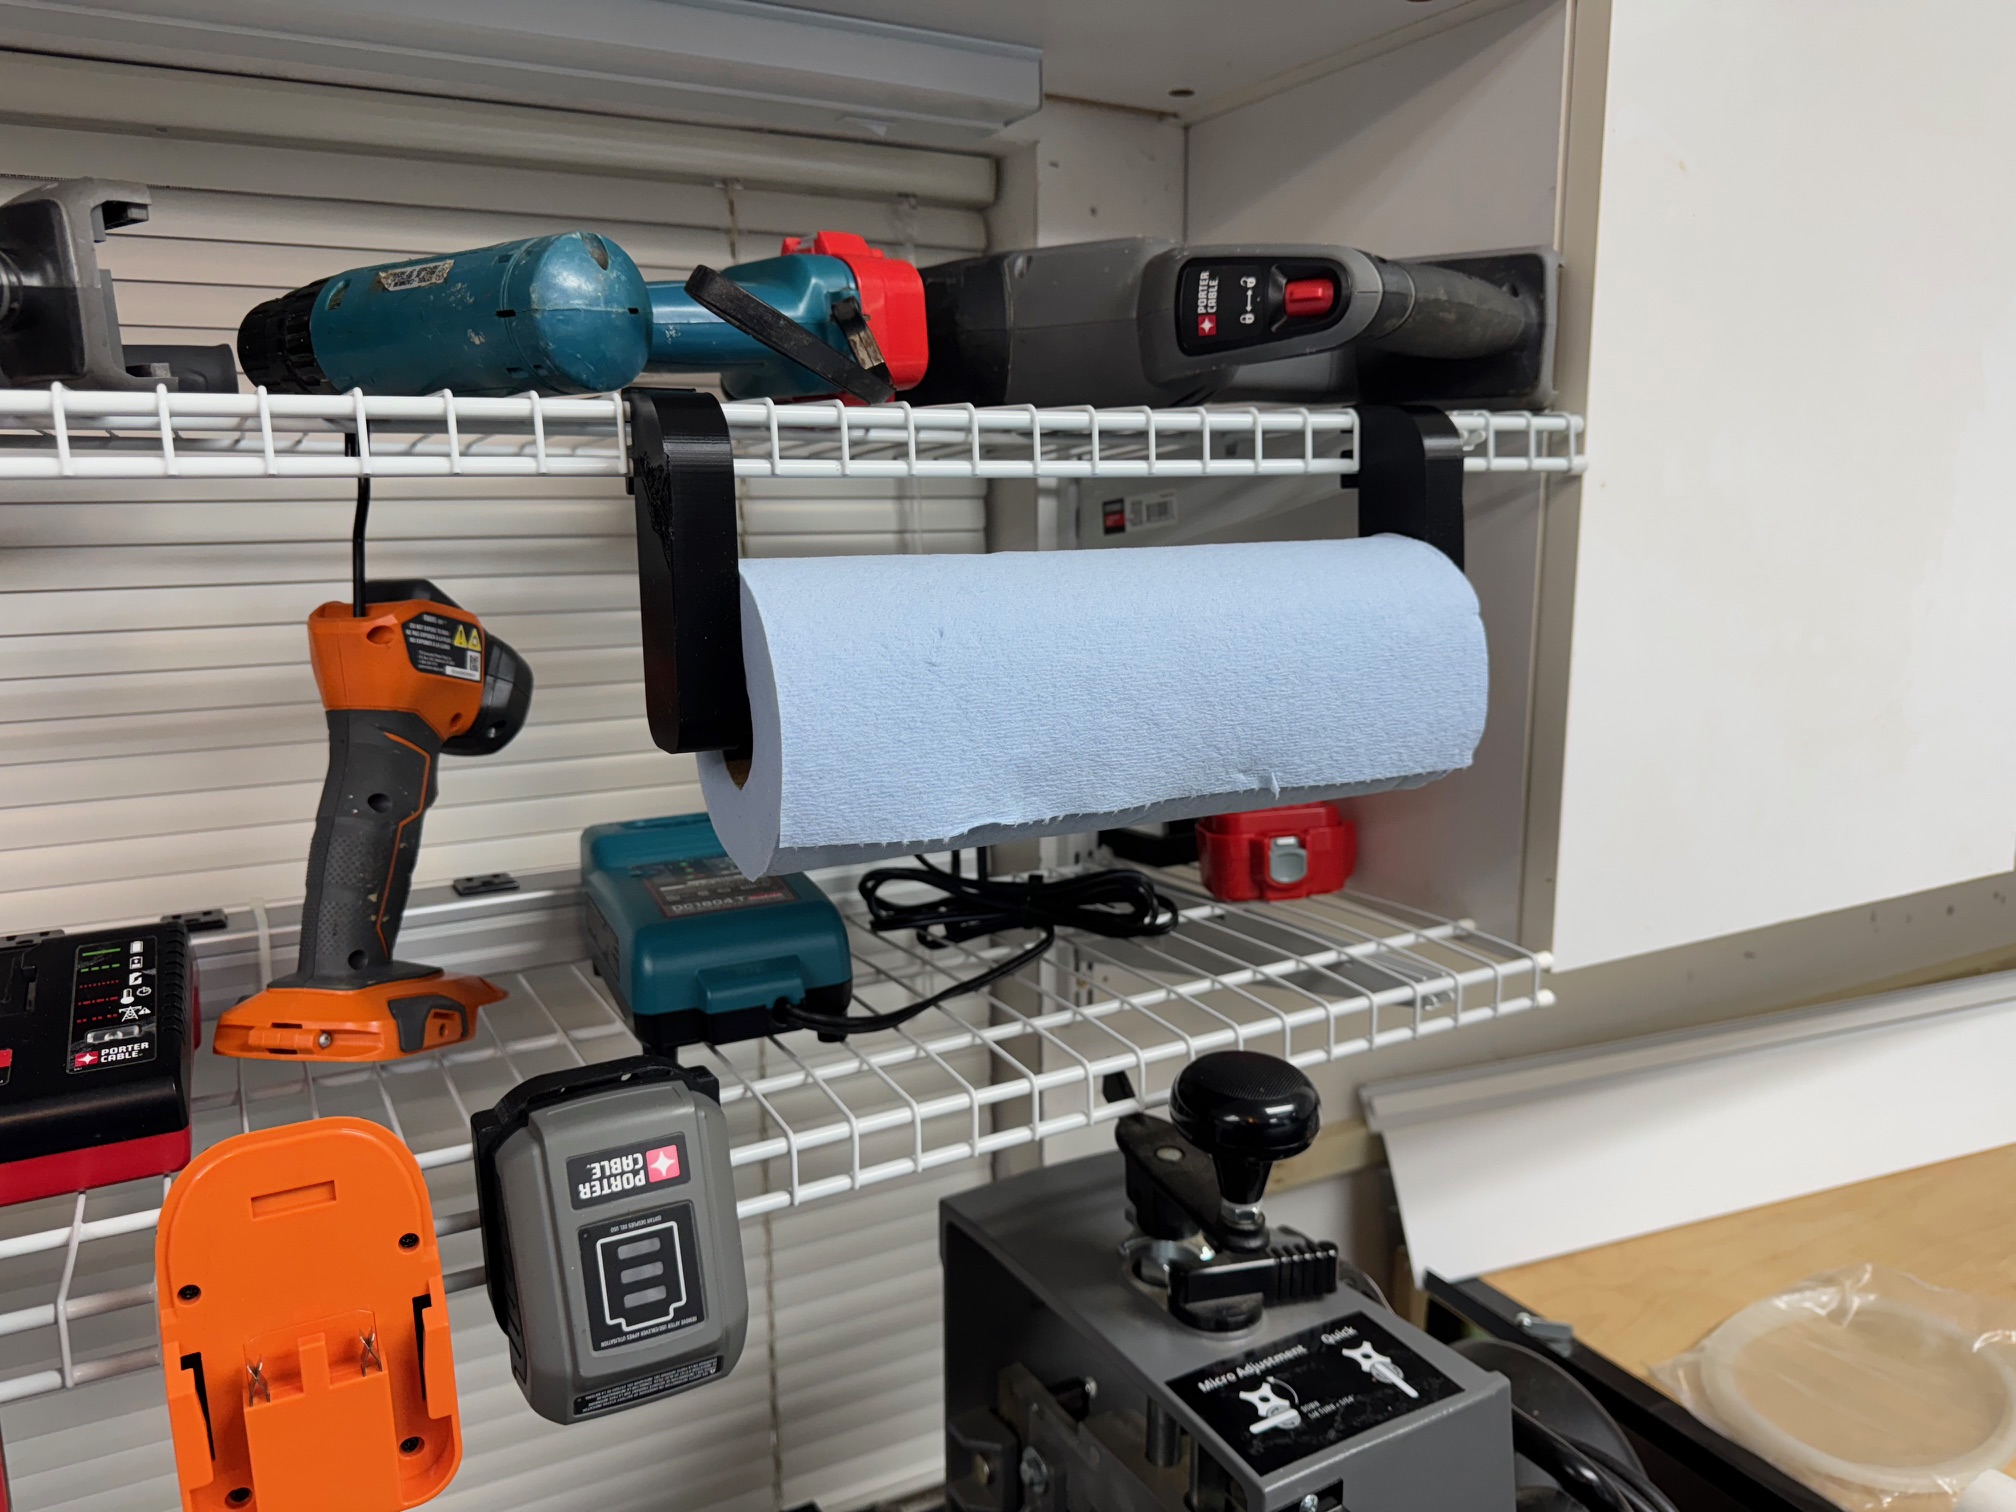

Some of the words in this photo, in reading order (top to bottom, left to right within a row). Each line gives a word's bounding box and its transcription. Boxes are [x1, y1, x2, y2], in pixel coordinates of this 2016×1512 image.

[1197, 270, 1210, 314] PORTER
[1207, 277, 1219, 313] CABLE
[101, 1042, 149, 1056] PORTER
[101, 1051, 139, 1063] CABLE
[578, 1170, 646, 1199] PORTER
[667, 1320, 680, 1329] AFTER
[681, 1316, 698, 1325] REMOVE
[1321, 1326, 1358, 1345] Quick
[1198, 1371, 1237, 1394] Micro
[1236, 1344, 1308, 1379] Adjustment
